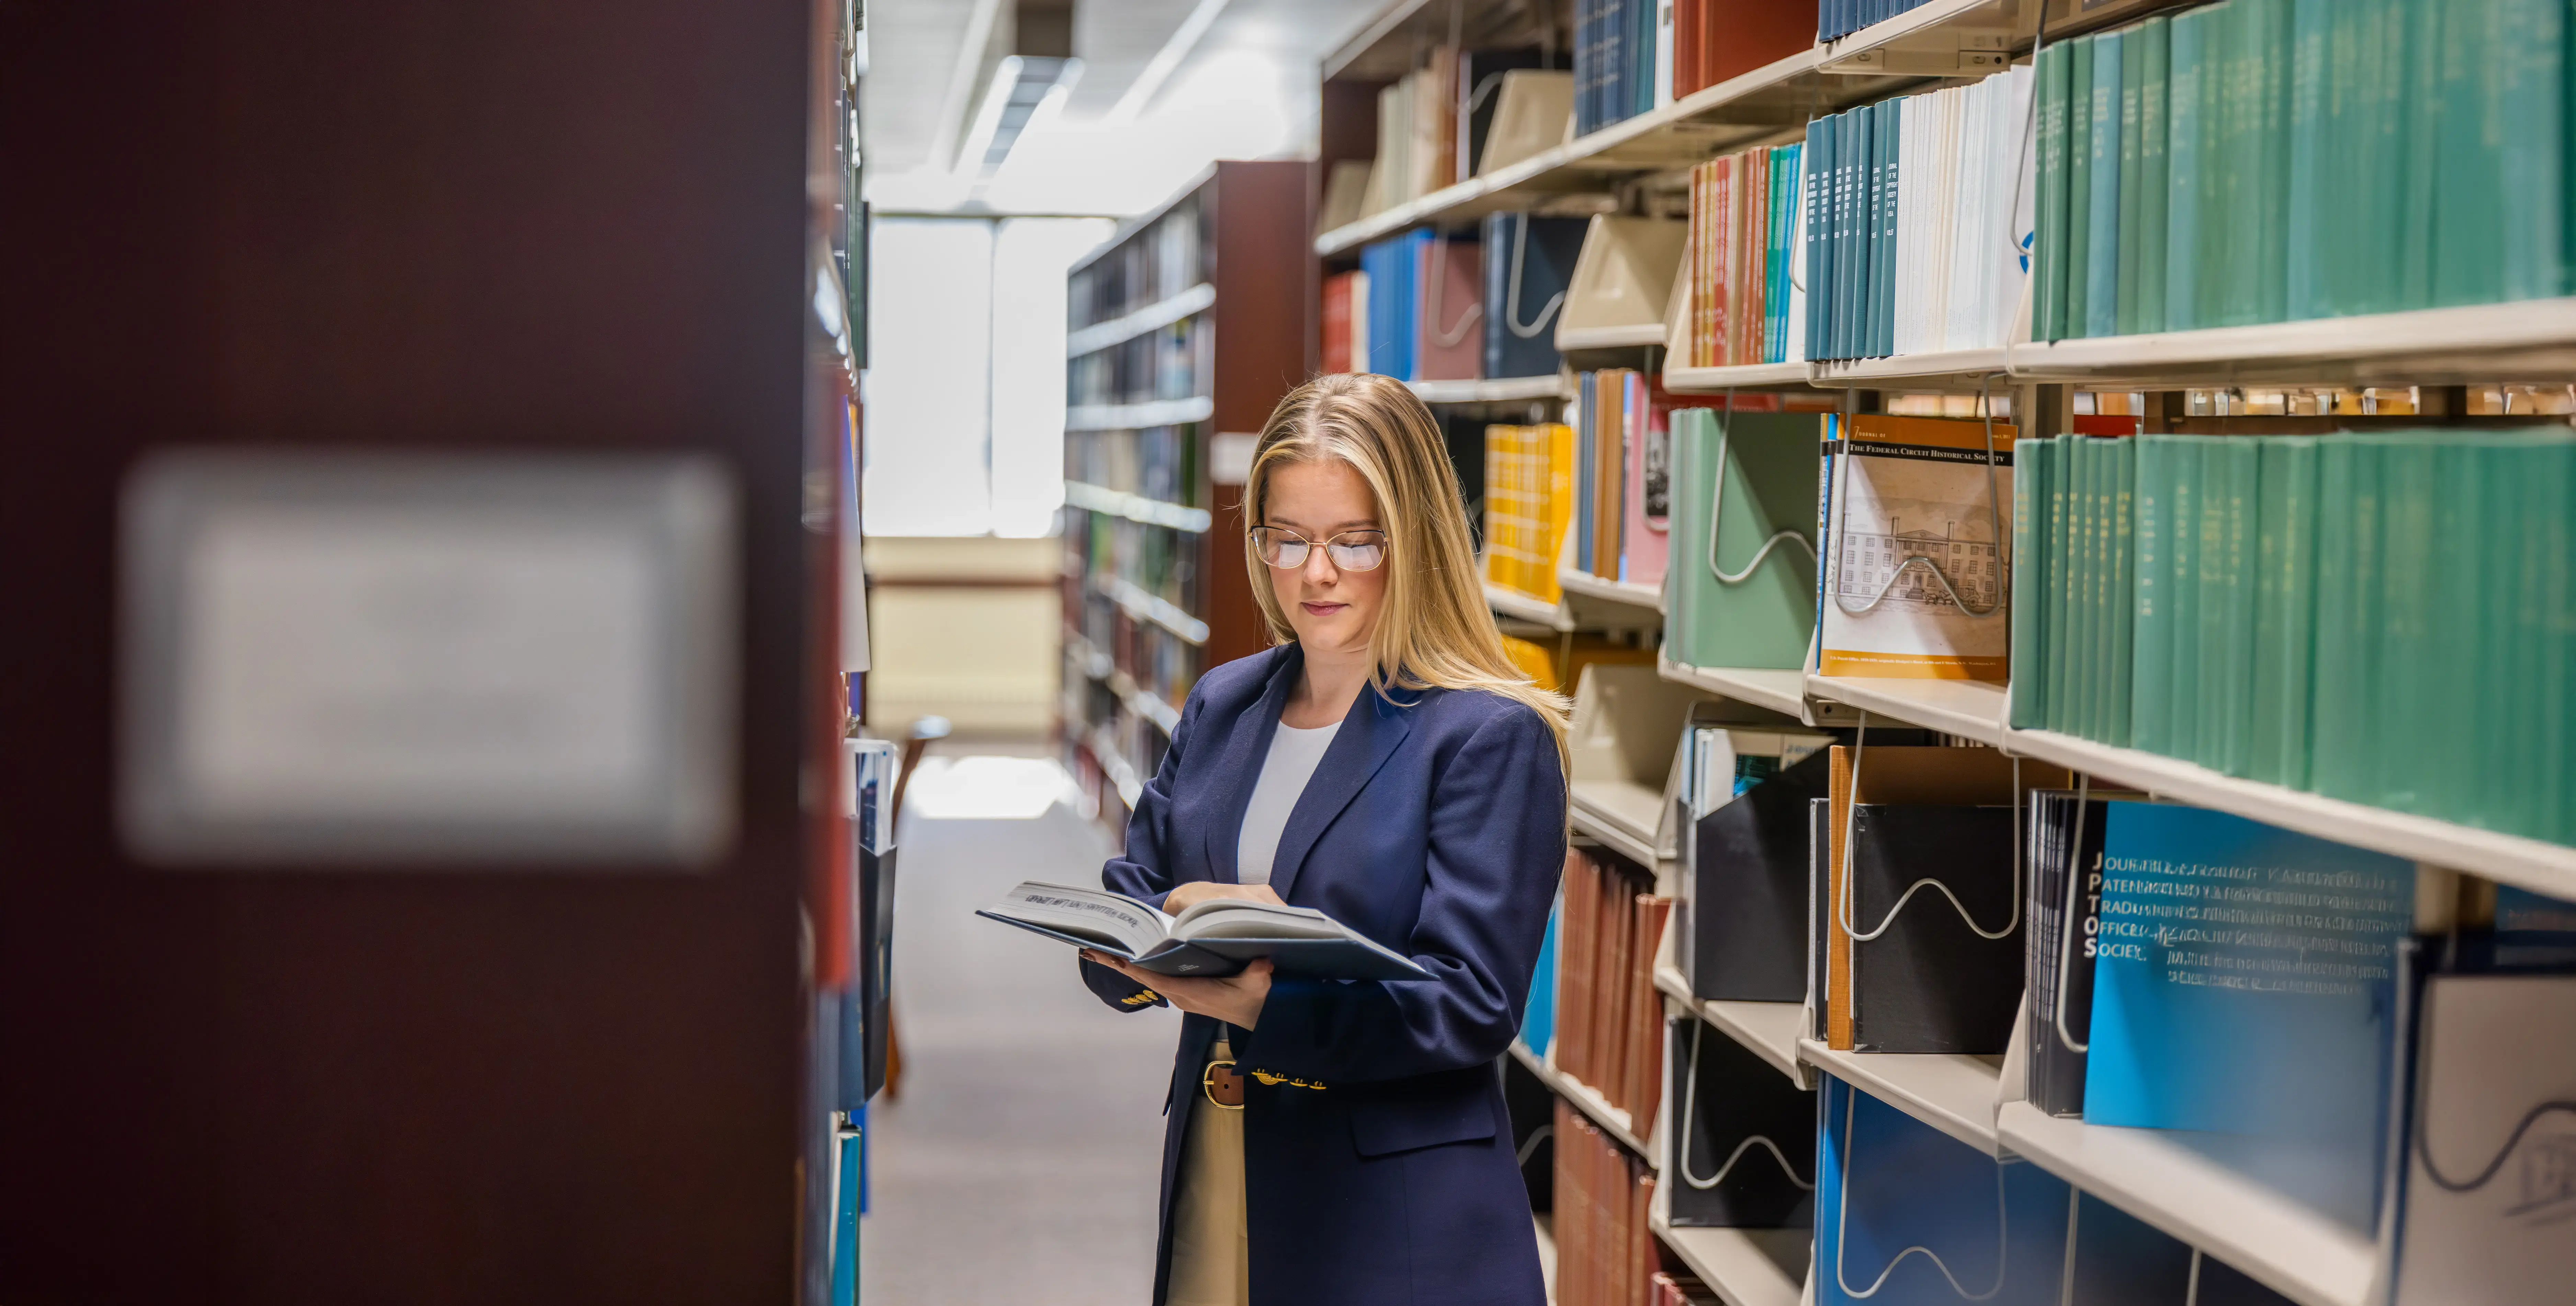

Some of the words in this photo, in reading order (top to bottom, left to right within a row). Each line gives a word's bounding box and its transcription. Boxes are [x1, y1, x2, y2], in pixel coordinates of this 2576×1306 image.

[1866, 445, 1899, 454] FEDERAL
[1900, 448, 1929, 457] CIRCUIT
[1931, 450, 1972, 460] HISTORICAL
[1974, 453, 2004, 462] SOCTY
